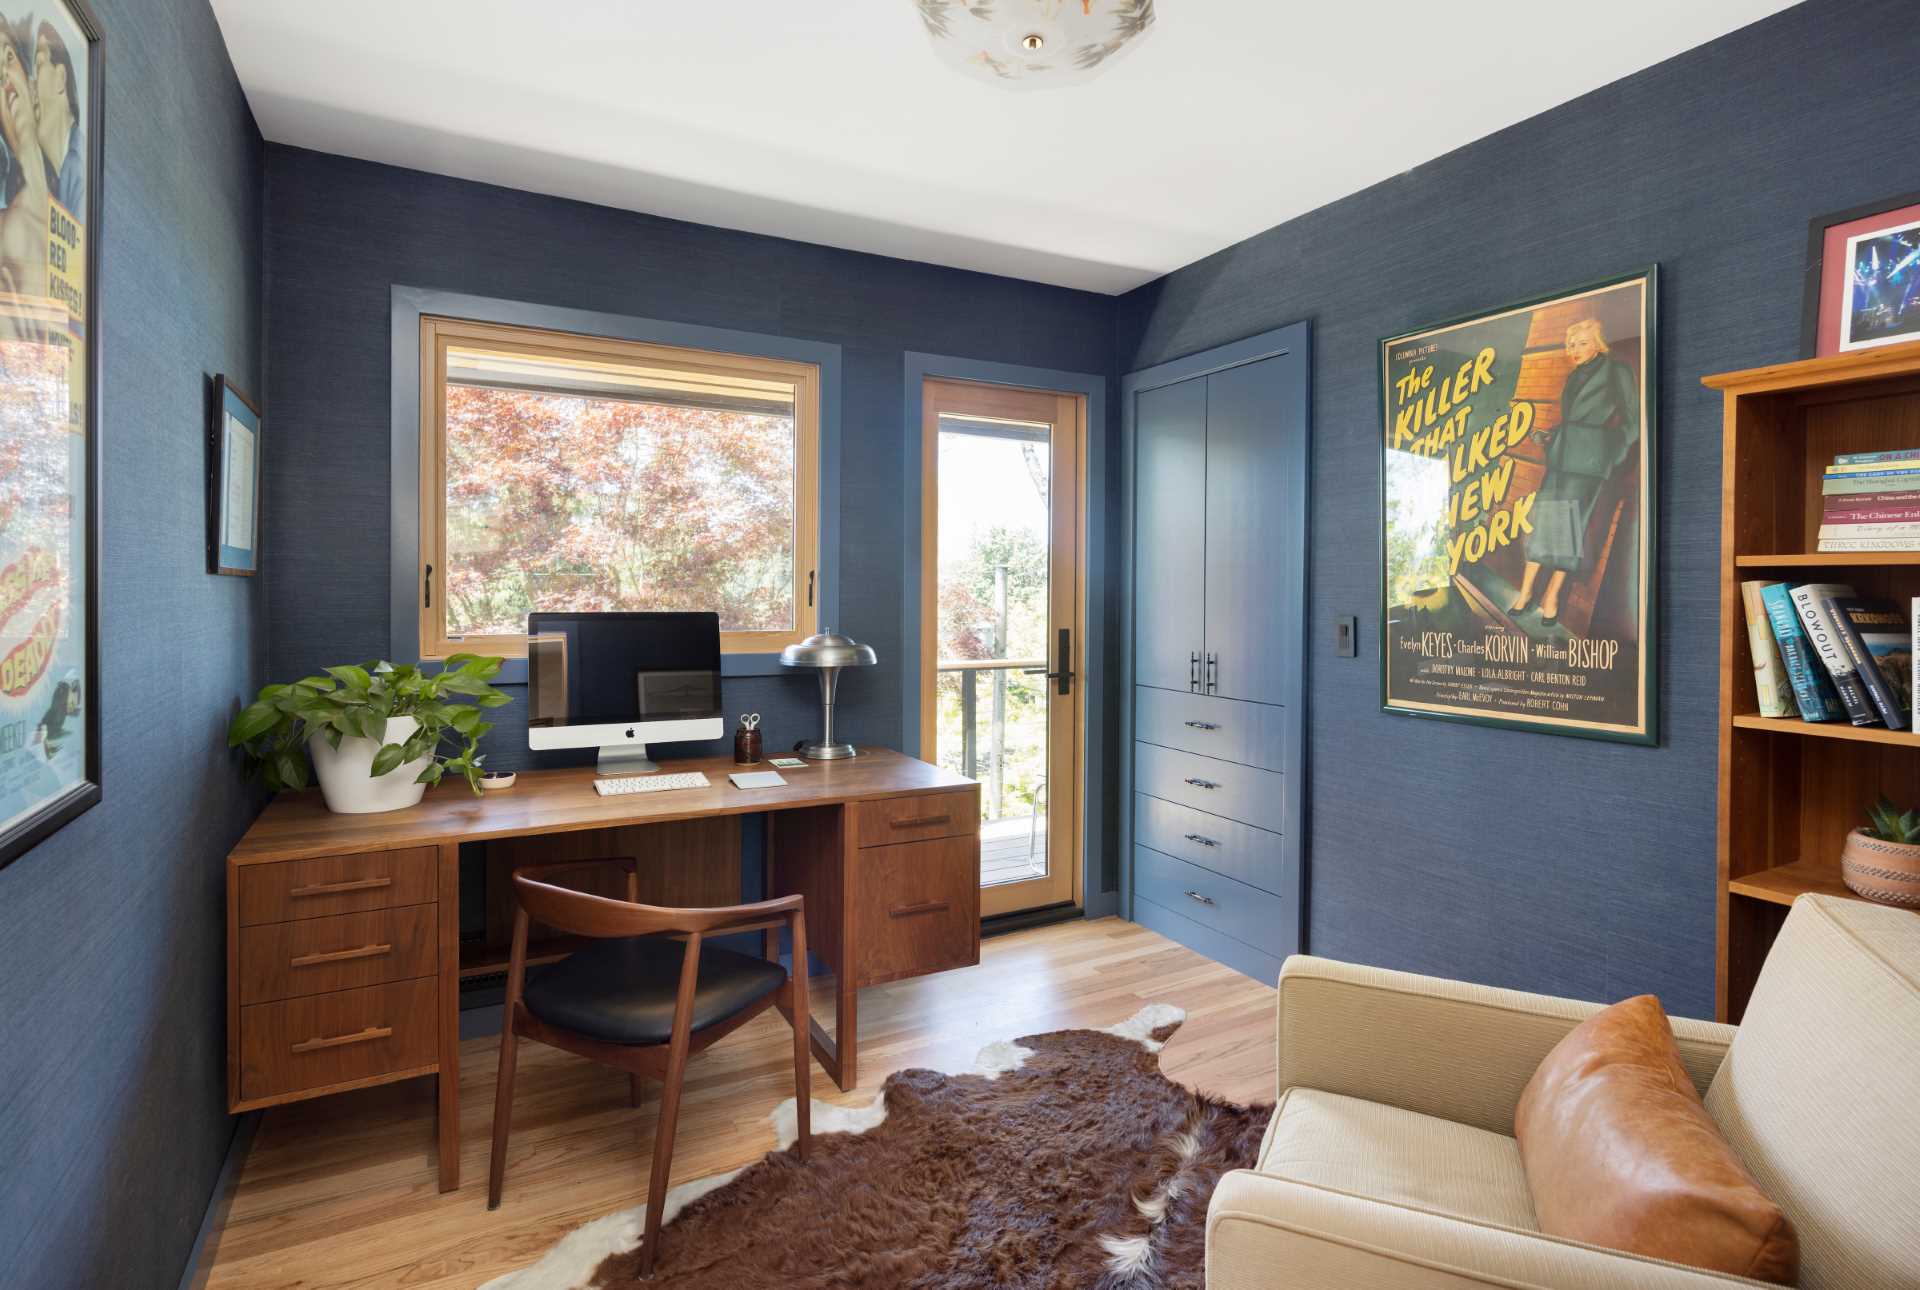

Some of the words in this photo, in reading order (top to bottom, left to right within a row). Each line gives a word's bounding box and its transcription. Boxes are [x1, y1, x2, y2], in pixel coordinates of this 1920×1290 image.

[50, 239, 67, 272] RED
[1394, 347, 1496, 448] KILLER
[1395, 365, 1434, 406] The
[1410, 406, 1472, 458] THAT
[1447, 492, 1536, 576] YORK
[1850, 512, 1868, 520] The
[1869, 511, 1904, 519] Chinese
[1797, 594, 1837, 659] BLOWOUT
[1400, 636, 1421, 652] Evelyn
[1421, 631, 1453, 658] KEYES
[1457, 640, 1485, 655] Charles
[1485, 635, 1528, 664] KORVIN
[1536, 644, 1567, 660] William
[1568, 638, 1618, 670] BISHOP
[1497, 668, 1525, 681] ALBRIGHT
[1531, 672, 1546, 683] CARL
[1546, 673, 1570, 686] BENTON
[1572, 675, 1586, 686] REID
[1526, 699, 1550, 709] ROBERT
